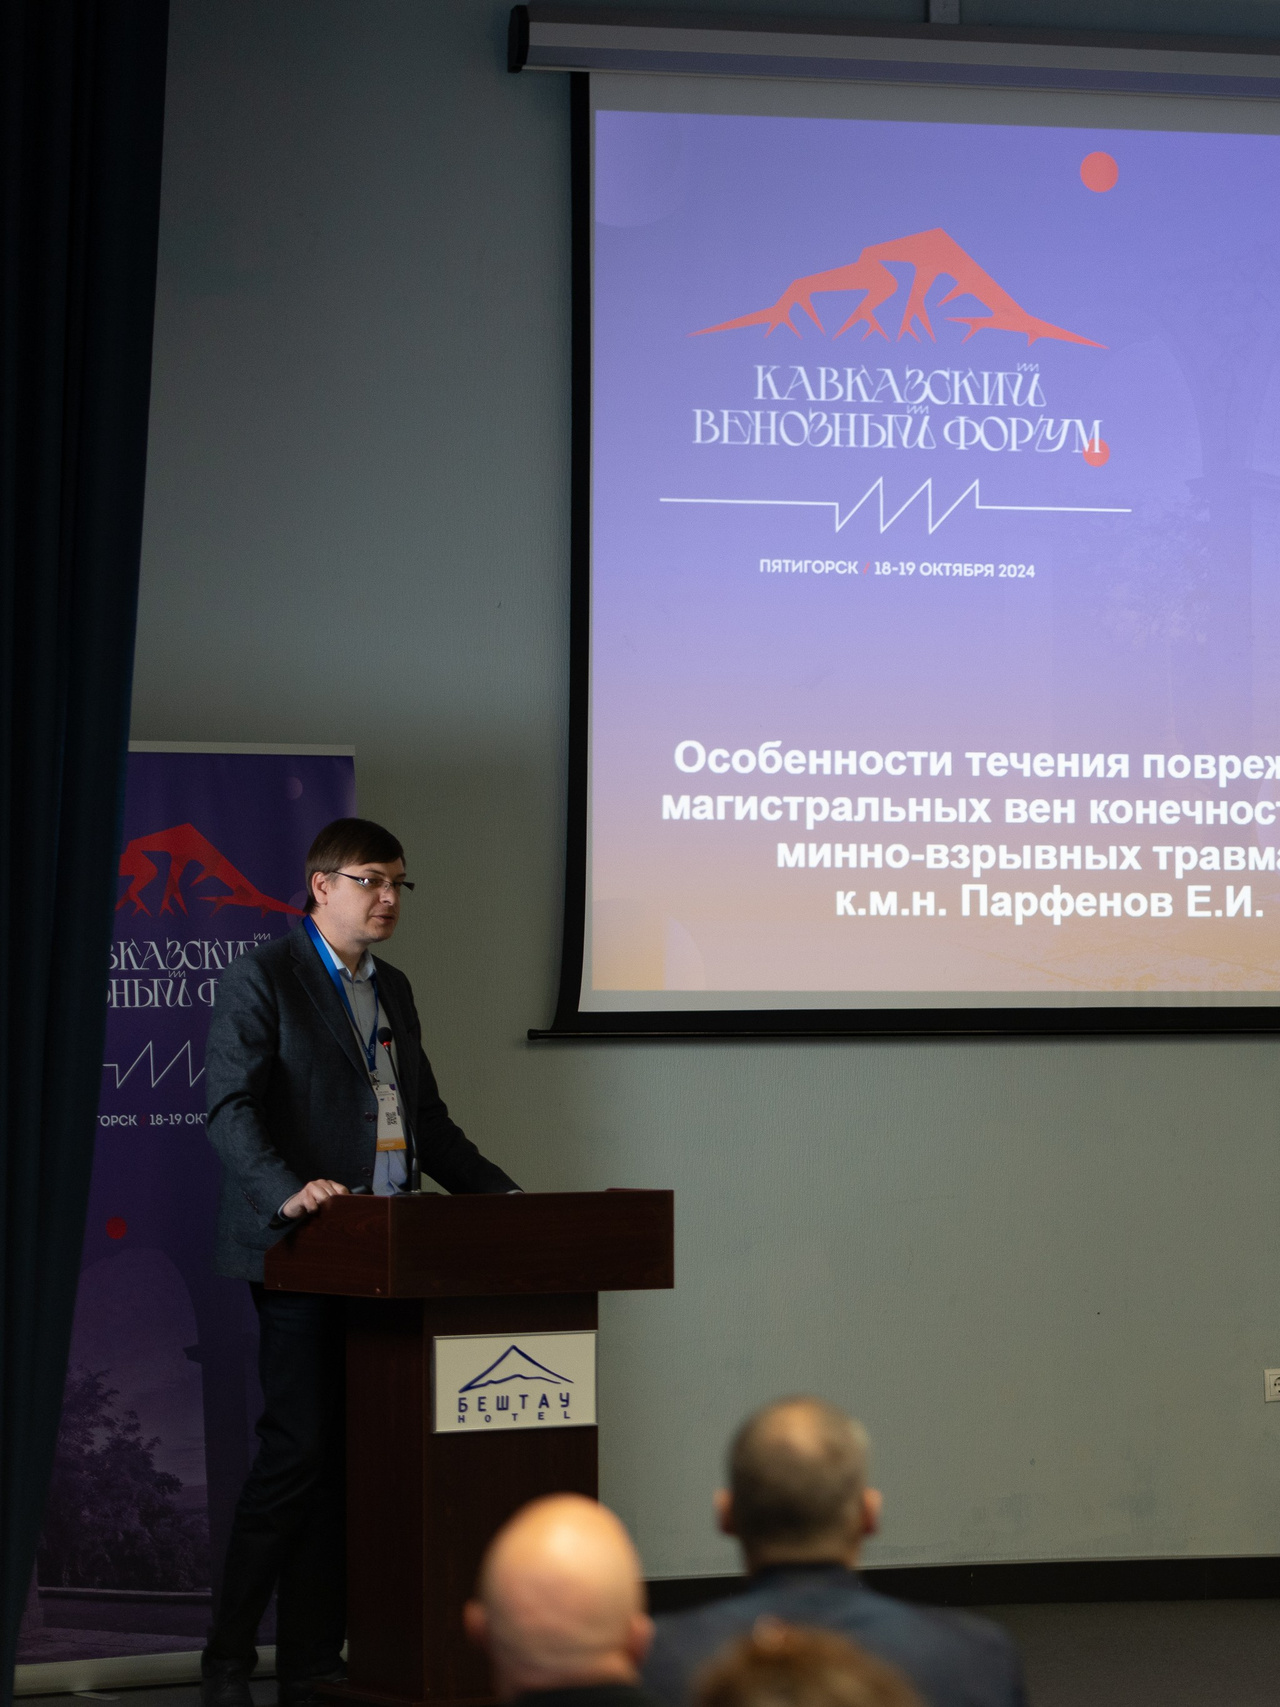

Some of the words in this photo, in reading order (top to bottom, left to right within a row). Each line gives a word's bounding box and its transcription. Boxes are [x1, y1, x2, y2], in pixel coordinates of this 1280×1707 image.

[753, 363, 1047, 408] КАВКАЗСКИЙ
[692, 405, 937, 450] ВЕНОЗНЫЙ
[943, 414, 1104, 454] ФОРУМ
[759, 558, 859, 575] ПЯТИГОРСК
[874, 560, 916, 576] 18-19
[919, 562, 995, 577] ОКТЯБРЯ
[998, 563, 1036, 578] 2024
[673, 740, 953, 778] Особенности
[964, 751, 1131, 779] течения
[661, 794, 993, 828] магистральных
[1004, 799, 1077, 824] вен
[776, 842, 1143, 878] минно-взрывных
[835, 890, 948, 917] к.м.н.
[961, 883, 1174, 925] Парфенов
[1187, 884, 1265, 918] Е.И.
[107, 970, 193, 1008] НЫЙ
[149, 1113, 183, 1126] 18-19
[457, 1392, 571, 1413] БЕШТАУ
[457, 1411, 571, 1424] HOTEL
